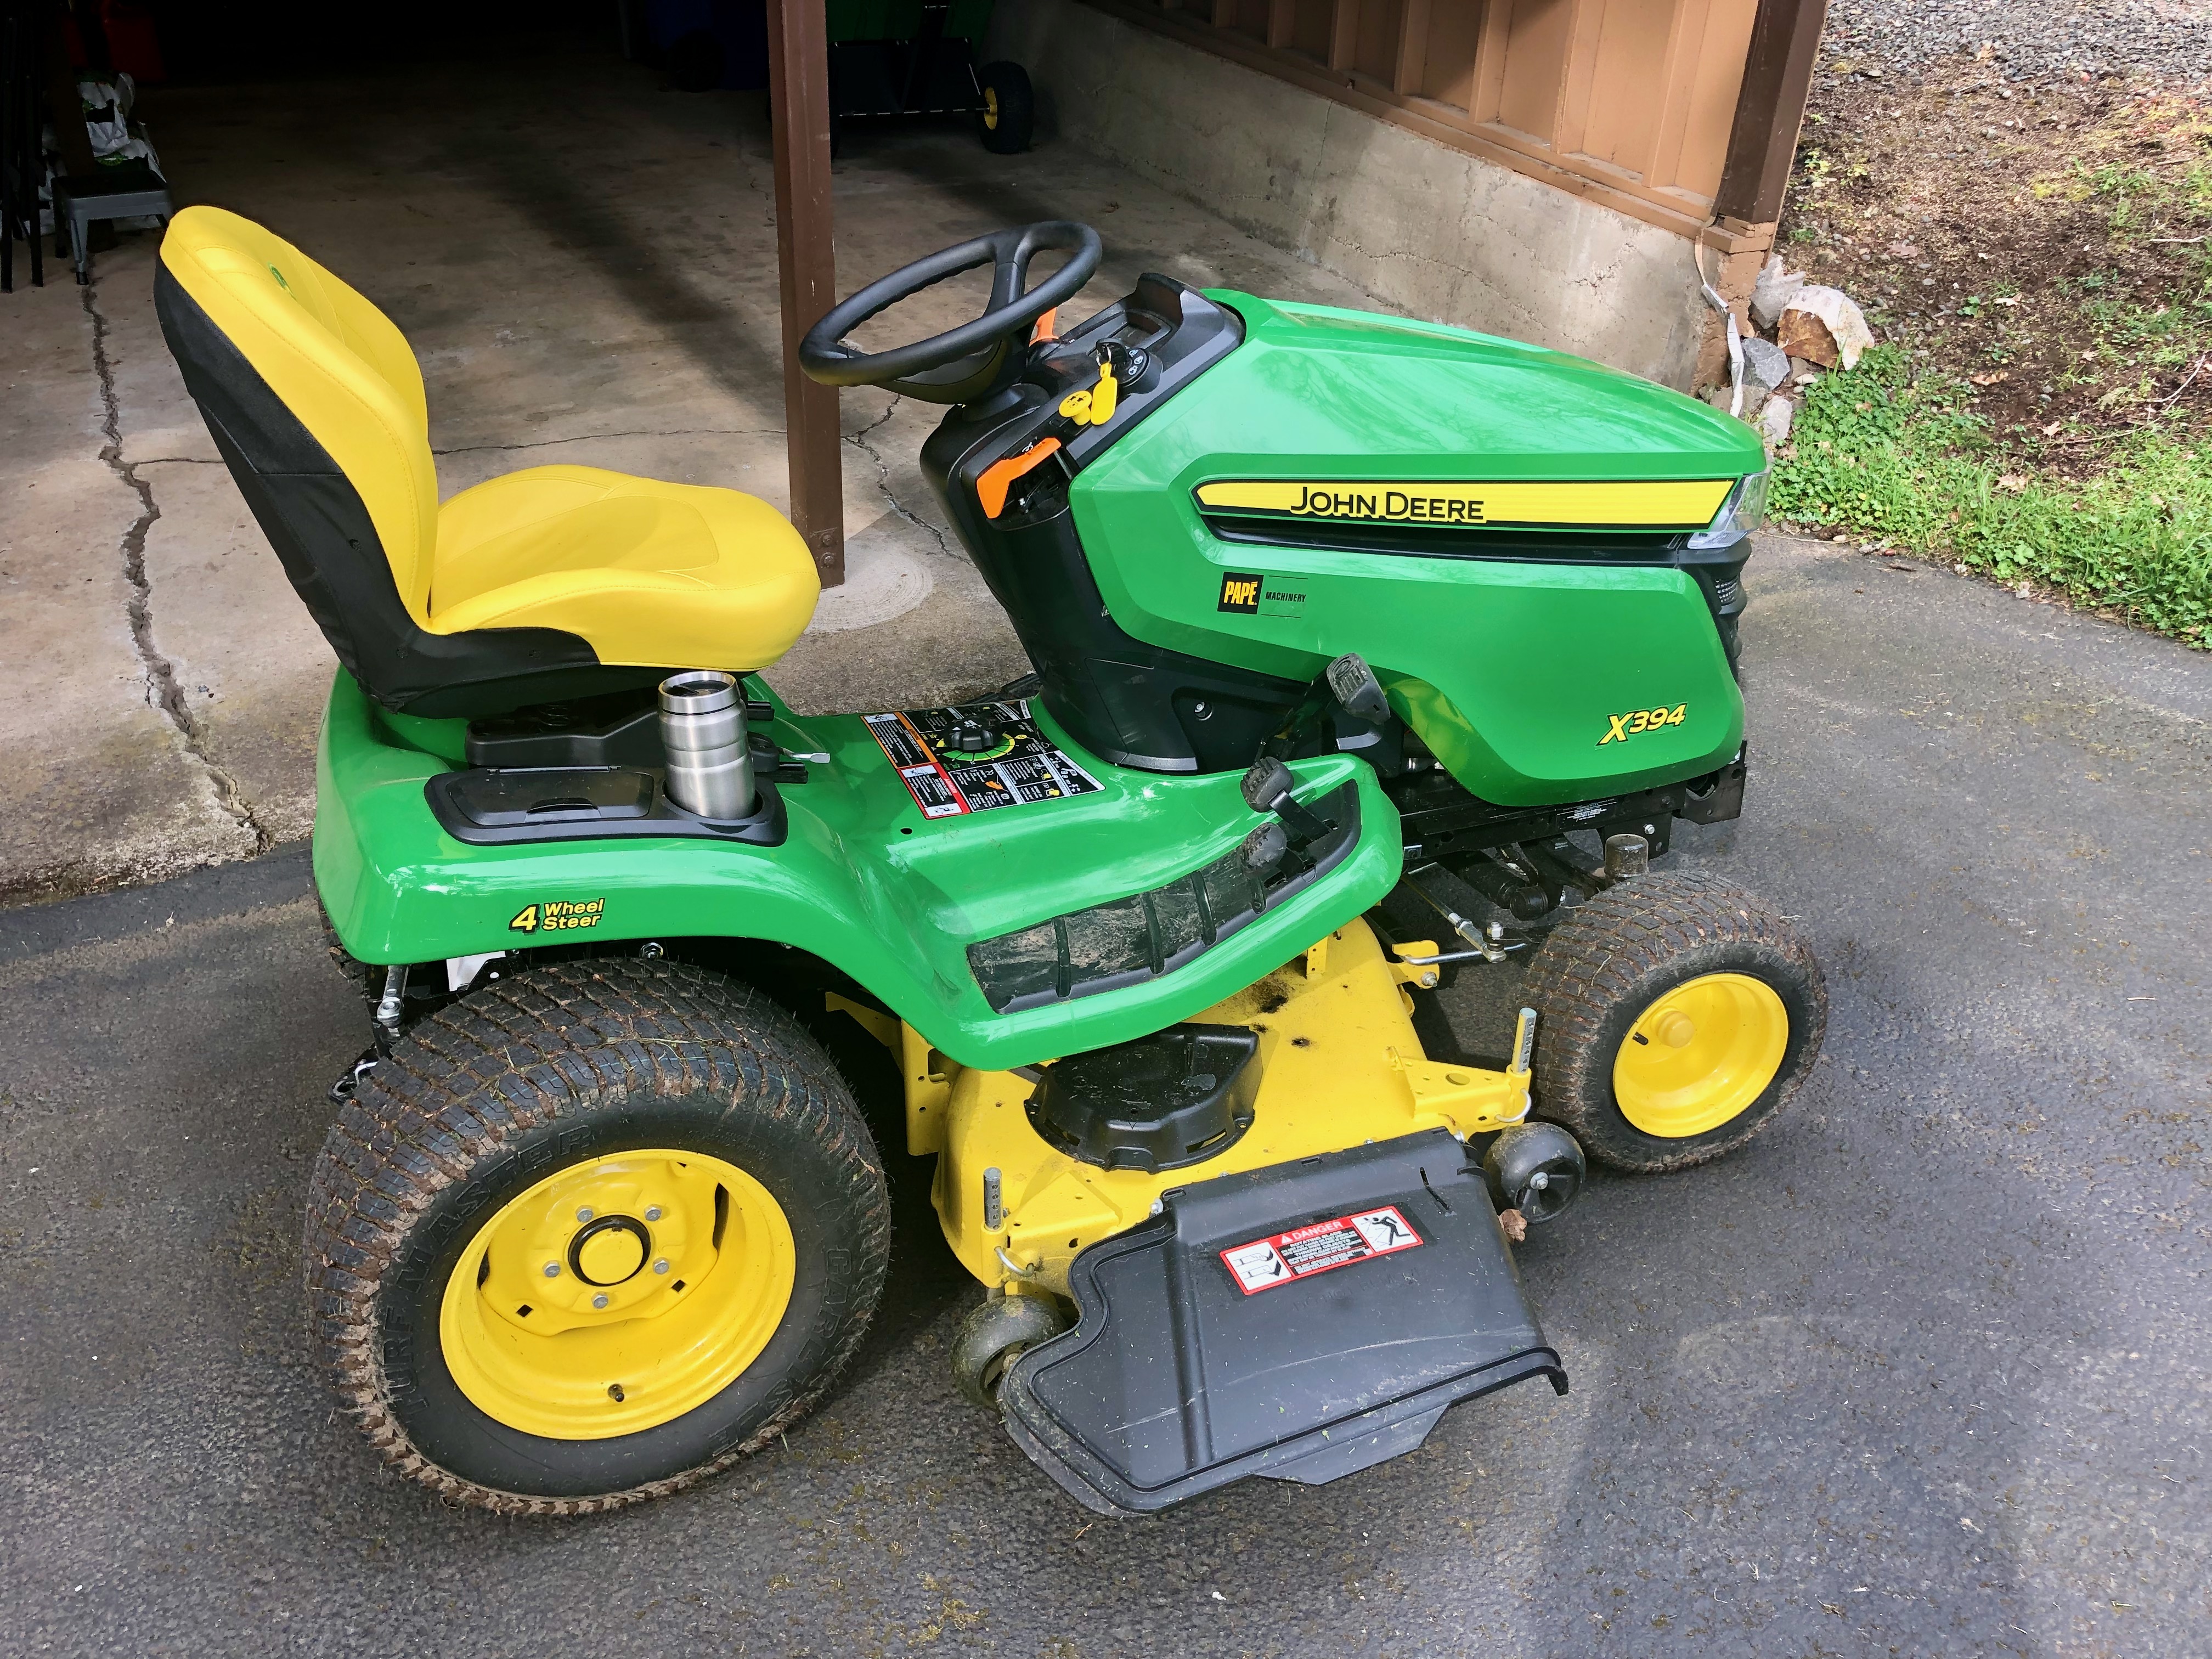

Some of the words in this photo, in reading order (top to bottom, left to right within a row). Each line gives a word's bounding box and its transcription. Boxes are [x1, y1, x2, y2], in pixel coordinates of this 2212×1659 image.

[1290, 487, 1376, 515] JOHN
[1386, 492, 1484, 520] DEERE
[1265, 591, 1306, 602] MACHINERY
[1596, 702, 1688, 746] X394
[508, 904, 540, 933] 4
[544, 898, 606, 916] Wheel
[542, 914, 602, 931] Steer
[397, 1124, 594, 1293] MASTER
[1291, 1221, 1344, 1240] DANGER
[1294, 1246, 1322, 1257] THROWN
